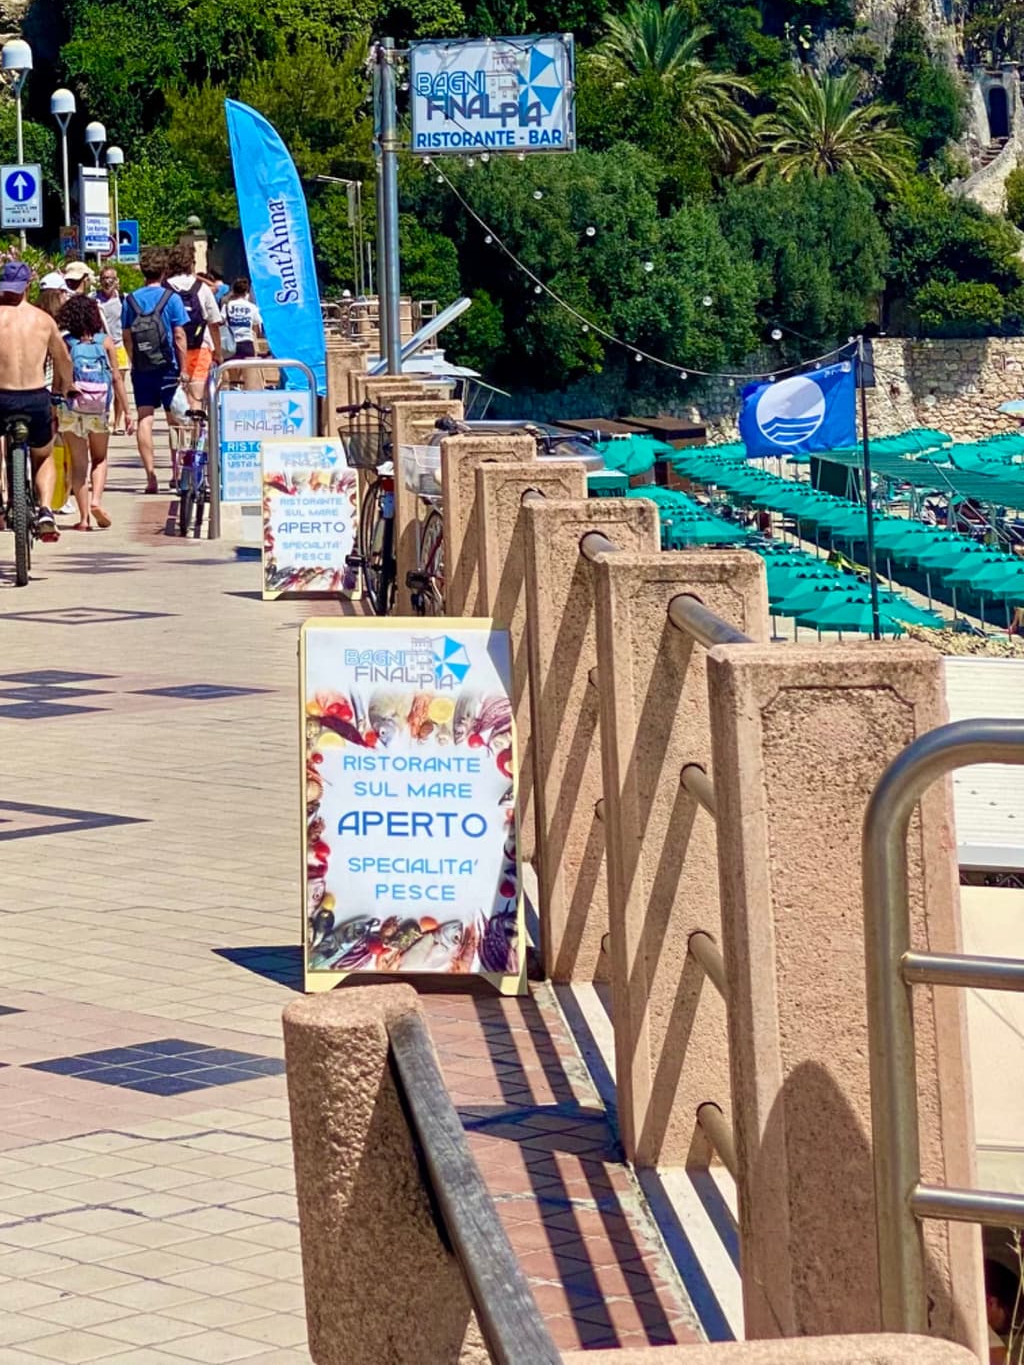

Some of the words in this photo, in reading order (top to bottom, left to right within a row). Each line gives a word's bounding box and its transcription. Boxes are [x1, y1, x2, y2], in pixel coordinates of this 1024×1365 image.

[417, 70, 486, 96] BAGNI
[417, 130, 515, 147] RISTORANTE
[528, 129, 562, 145] BAR
[268, 199, 300, 305] Sant'Anna
[229, 306, 251, 314] Jeep
[278, 521, 346, 534] APERTO
[344, 649, 406, 666] BAGNI
[343, 755, 481, 773] RISTORANTE
[354, 781, 398, 798] SUL
[408, 783, 473, 799] MARE
[338, 811, 488, 839] APERTO
[348, 857, 478, 876] SPECIALITA'
[376, 884, 456, 901] PESCE
